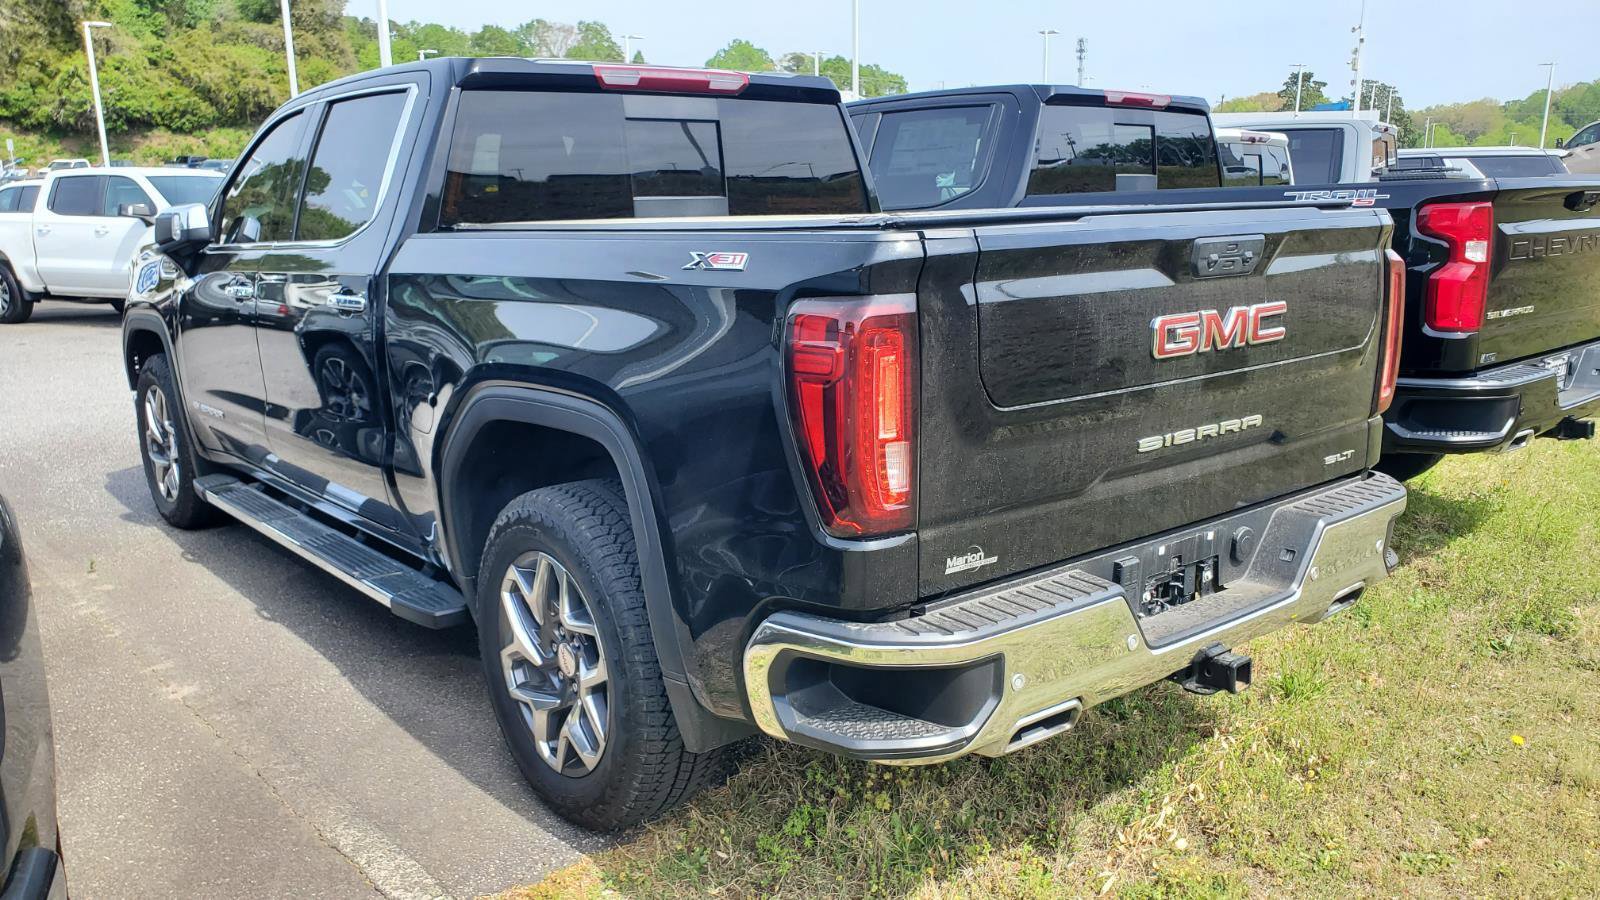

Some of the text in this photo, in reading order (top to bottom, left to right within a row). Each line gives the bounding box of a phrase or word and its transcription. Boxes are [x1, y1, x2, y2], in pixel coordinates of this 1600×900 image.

[1150, 300, 1288, 360] GMC
[1137, 414, 1263, 453] SIERRA
[1323, 449, 1356, 465] SLT
[946, 552, 985, 568] Marion
